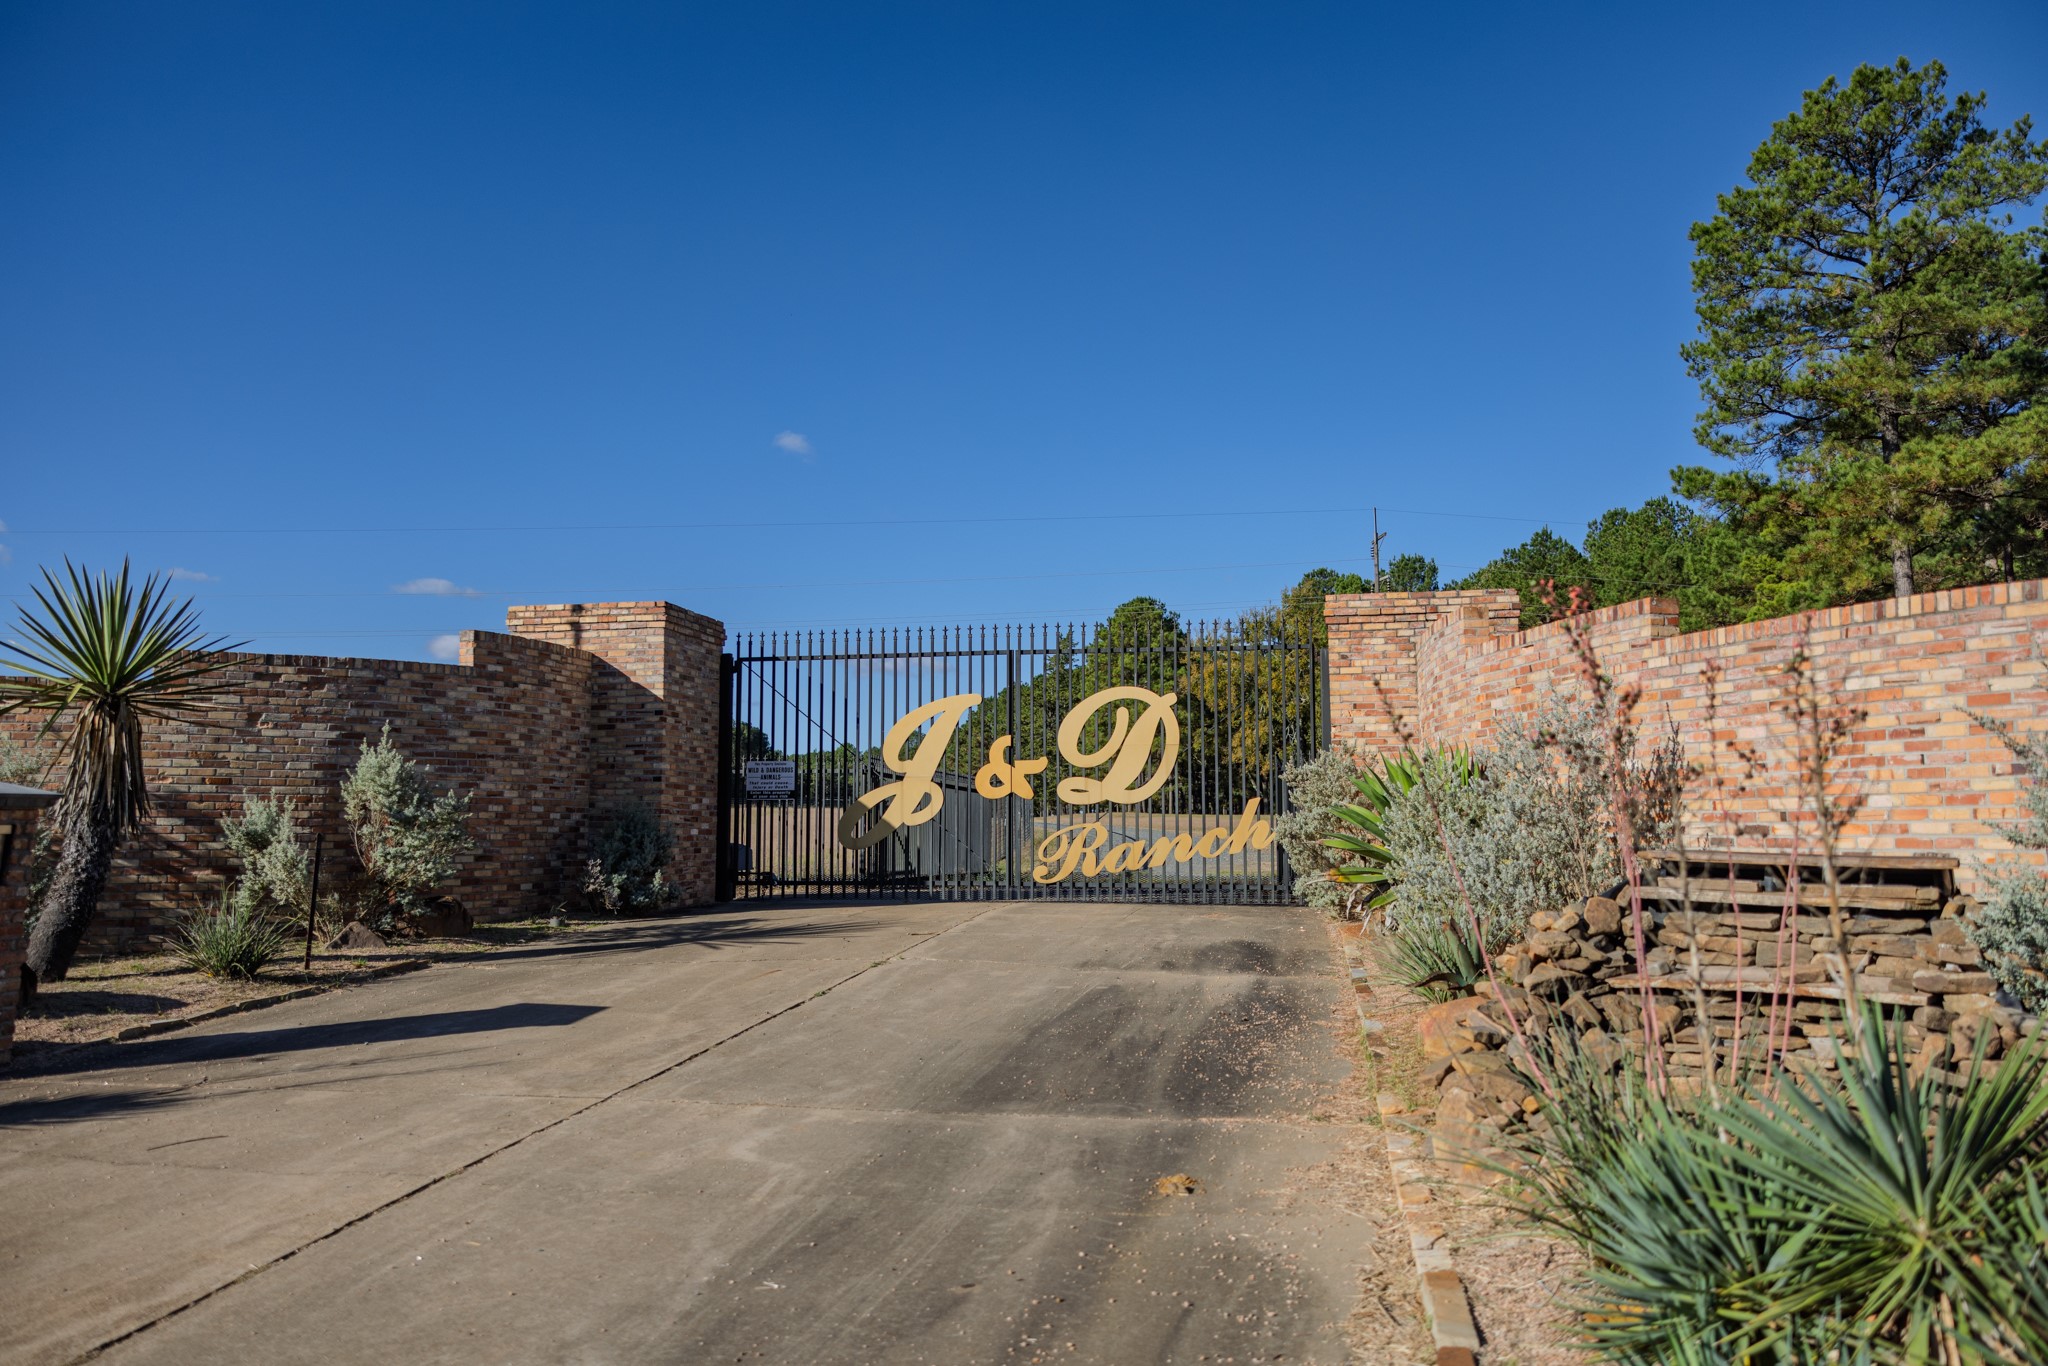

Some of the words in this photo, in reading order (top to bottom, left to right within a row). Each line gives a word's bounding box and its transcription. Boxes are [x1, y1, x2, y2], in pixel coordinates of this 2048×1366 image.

[838, 693, 983, 851] J
[975, 734, 1049, 800] &
[1057, 686, 1181, 804] D
[1032, 797, 1276, 884] Ranch
